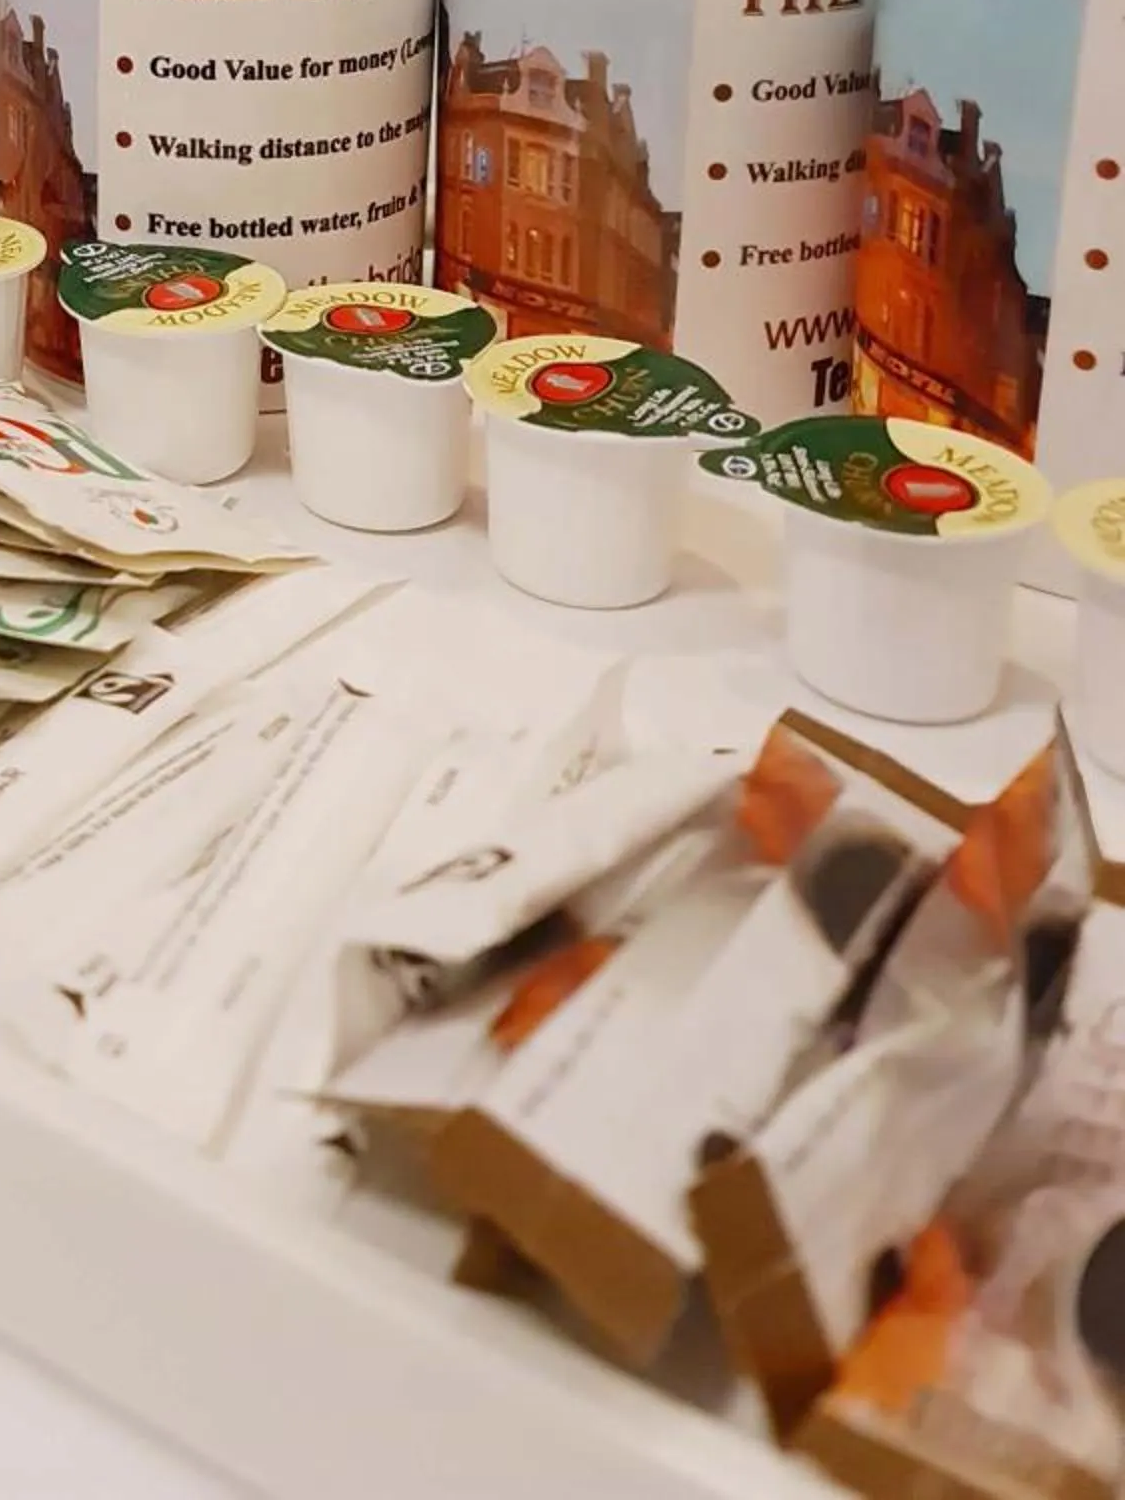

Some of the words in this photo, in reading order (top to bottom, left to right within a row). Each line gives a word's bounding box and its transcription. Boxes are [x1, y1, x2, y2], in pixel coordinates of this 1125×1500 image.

[149, 55, 217, 81] Good
[224, 59, 294, 81] Value
[299, 55, 334, 79] for
[339, 47, 398, 76] money
[751, 76, 817, 102] Good
[148, 133, 254, 166] Walking
[259, 135, 352, 160] distance
[356, 130, 375, 148] to
[379, 120, 402, 143] the
[746, 157, 841, 185] Walking
[147, 212, 202, 238] Free
[209, 215, 294, 239] bottled
[300, 211, 363, 234] water,
[367, 195, 406, 225] fruits
[739, 244, 793, 267] Free
